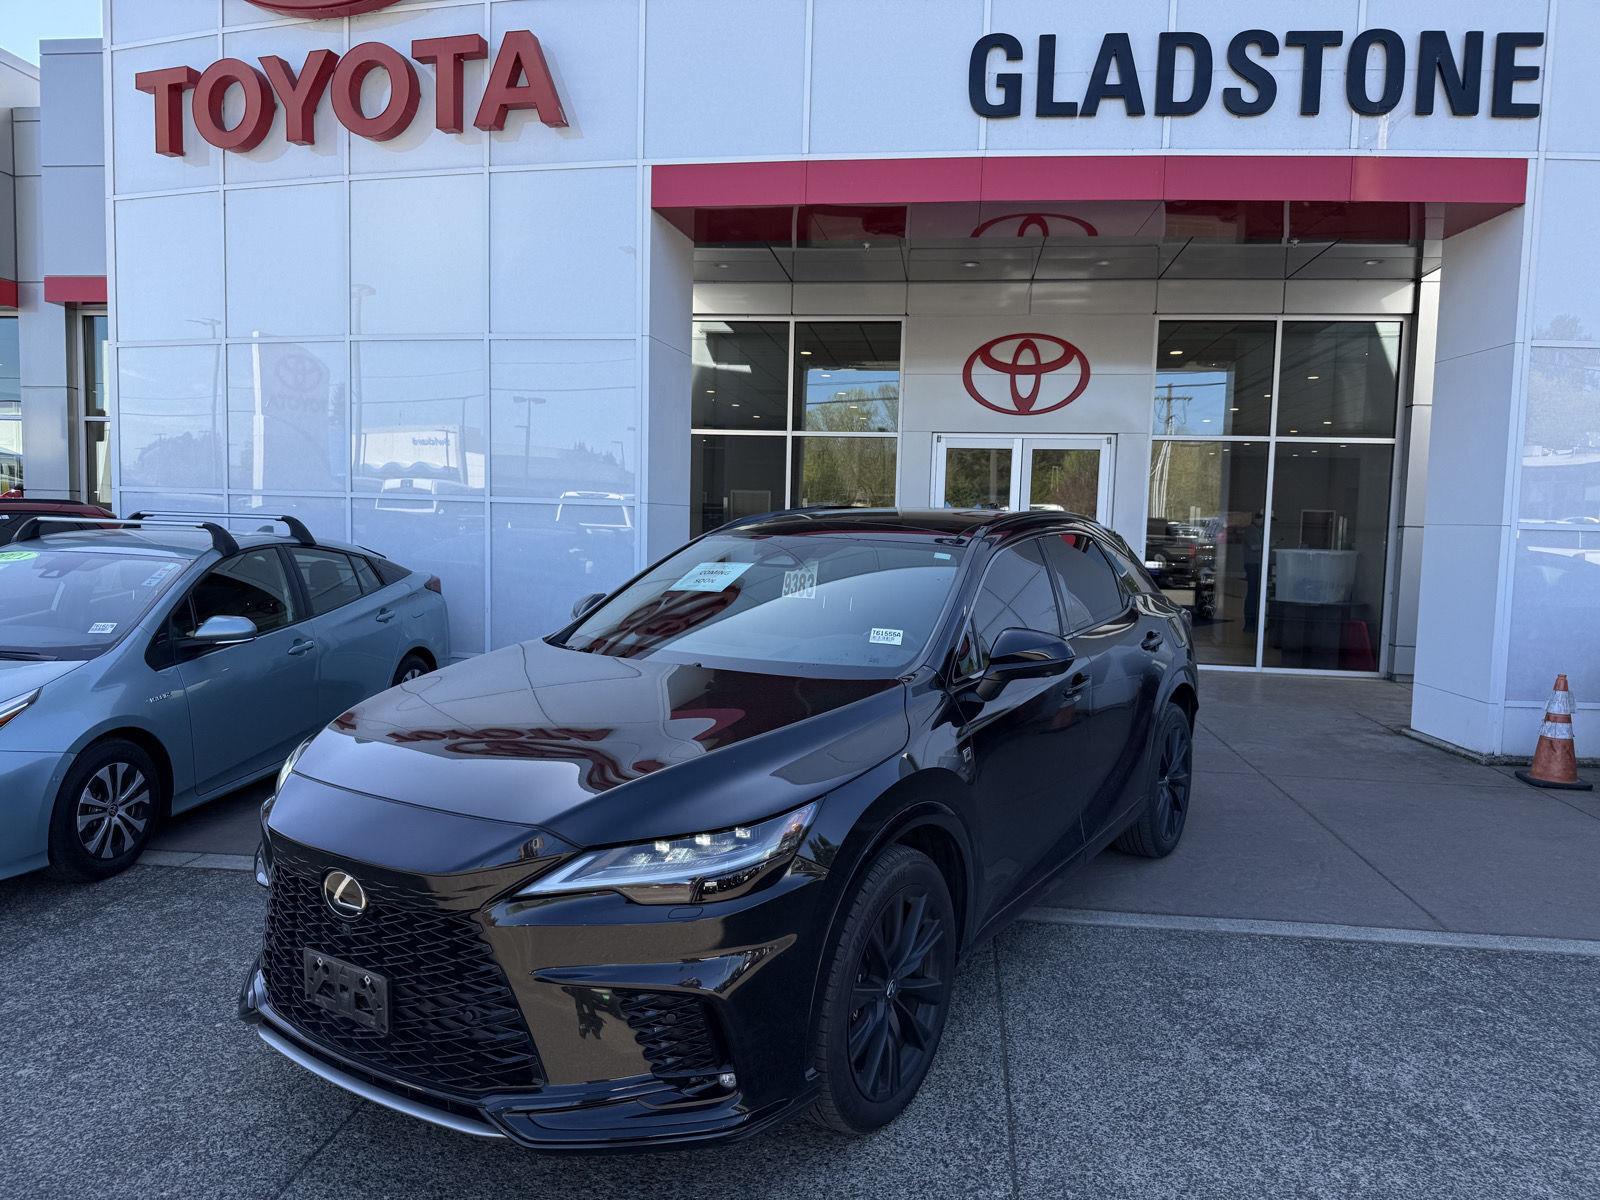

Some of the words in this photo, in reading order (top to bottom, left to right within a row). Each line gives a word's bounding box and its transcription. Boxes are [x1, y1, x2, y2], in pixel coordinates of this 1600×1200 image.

[135, 29, 569, 157] TOYOTA
[968, 28, 1545, 118] GLADSTONE
[783, 572, 815, 598] 9383
